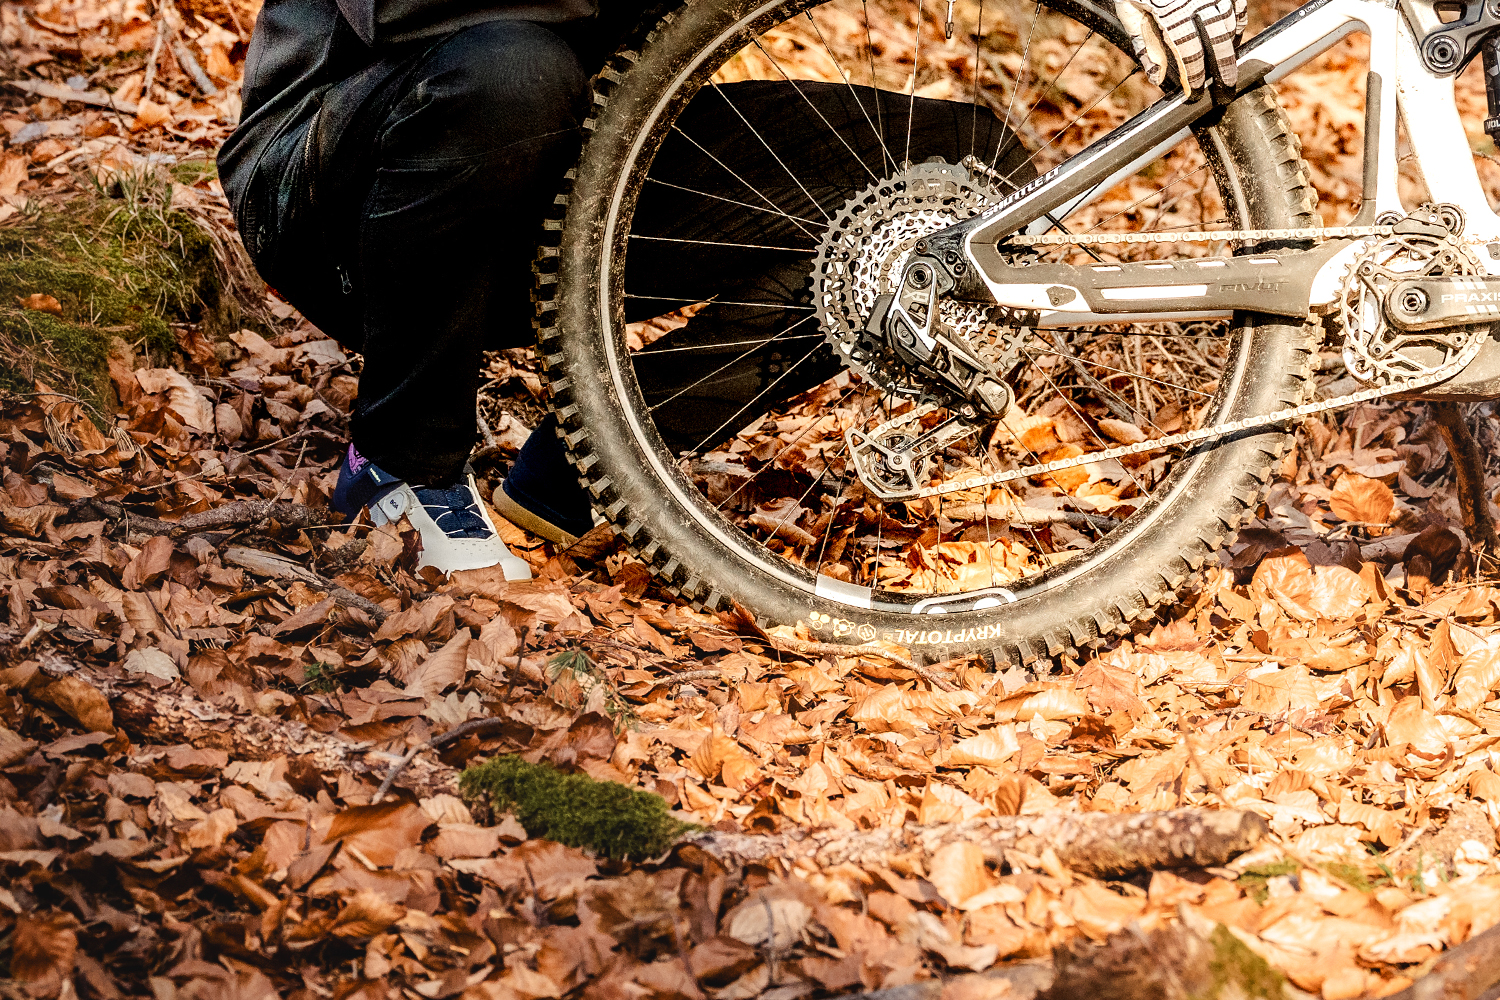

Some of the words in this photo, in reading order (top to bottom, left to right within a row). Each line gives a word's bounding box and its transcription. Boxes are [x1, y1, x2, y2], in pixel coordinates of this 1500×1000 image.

[981, 175, 1044, 220] SHUTTLE
[1044, 164, 1063, 182] LT
[894, 622, 1002, 645] KRYPTOTAL
